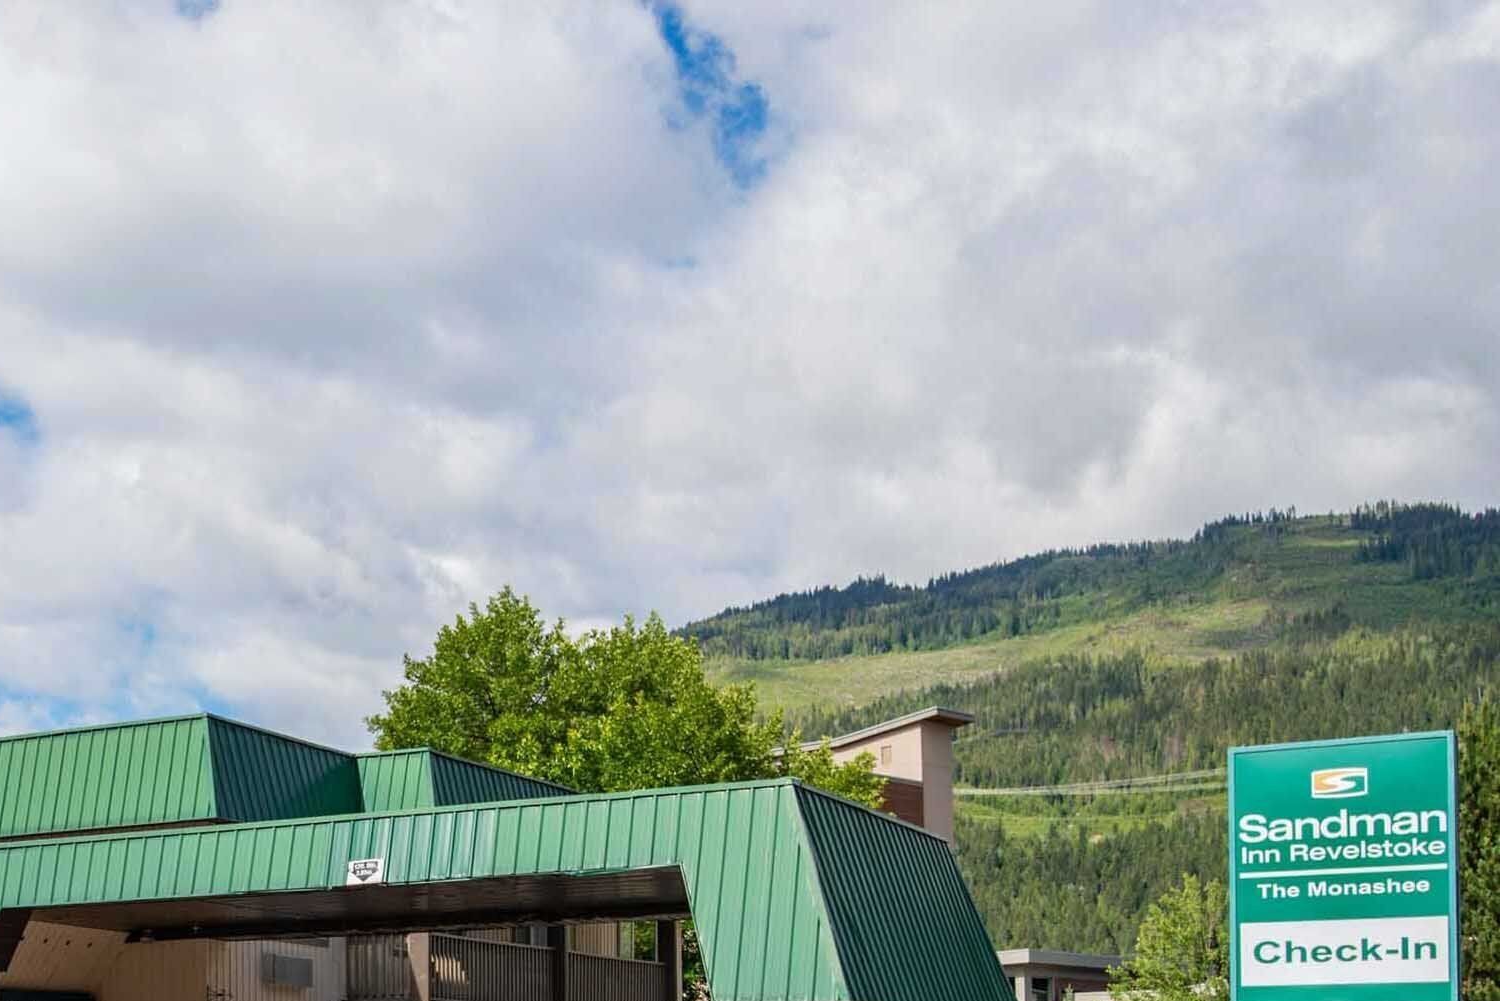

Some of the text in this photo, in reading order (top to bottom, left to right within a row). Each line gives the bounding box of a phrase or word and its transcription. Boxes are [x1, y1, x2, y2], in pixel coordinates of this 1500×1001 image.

[1239, 808, 1447, 843] Sandman
[1241, 838, 1446, 865] Inn Revelstoke
[1257, 878, 1431, 899] The Monashee
[1253, 937, 1437, 964] Check-In
